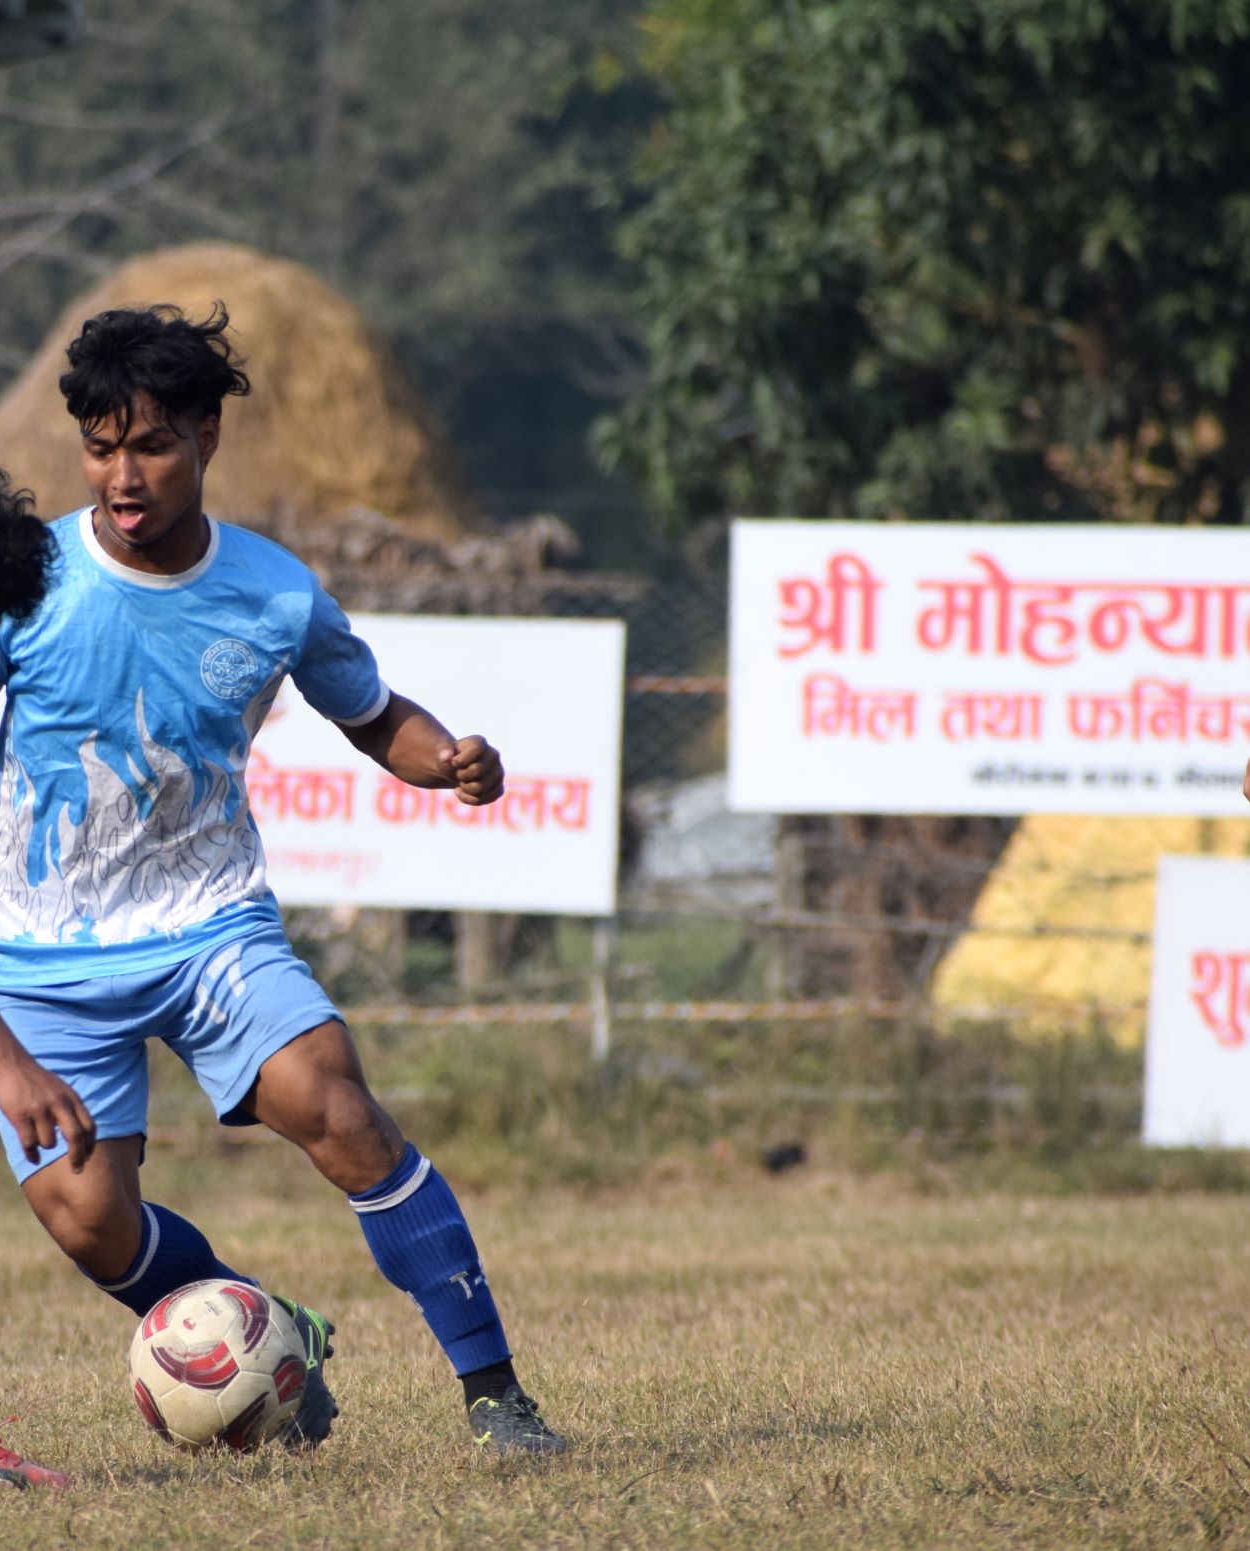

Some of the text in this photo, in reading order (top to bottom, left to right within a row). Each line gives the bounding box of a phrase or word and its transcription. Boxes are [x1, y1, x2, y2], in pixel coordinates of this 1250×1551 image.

[779, 552, 1250, 664] श्री मोहन्या
[803, 674, 918, 741] मिल
[942, 692, 1043, 741] तथा
